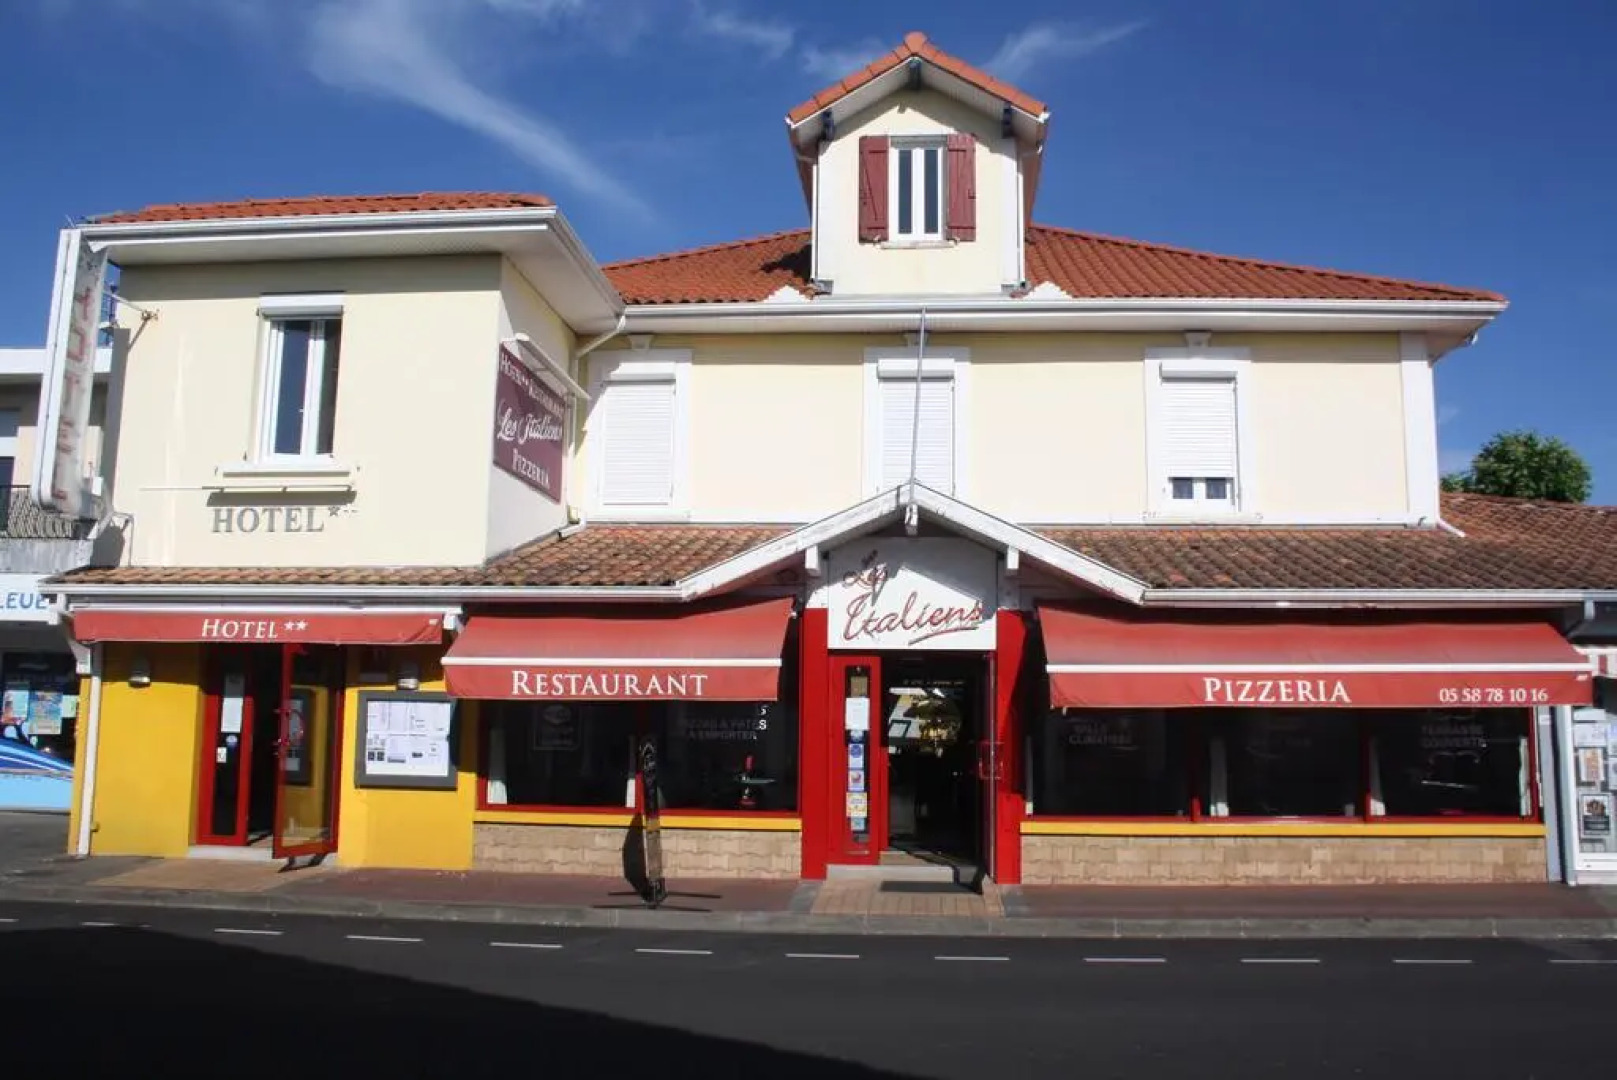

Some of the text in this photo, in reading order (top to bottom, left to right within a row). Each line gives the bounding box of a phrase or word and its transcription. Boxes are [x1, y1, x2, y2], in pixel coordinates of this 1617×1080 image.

[212, 507, 324, 533] HOTEL
[202, 618, 278, 639] HOTEL
[843, 591, 983, 641] Italiens
[511, 670, 708, 696] RESTAURANT
[1203, 677, 1352, 703] PIZZERIA
[1439, 688, 1548, 702] 05 58 78 10 16
